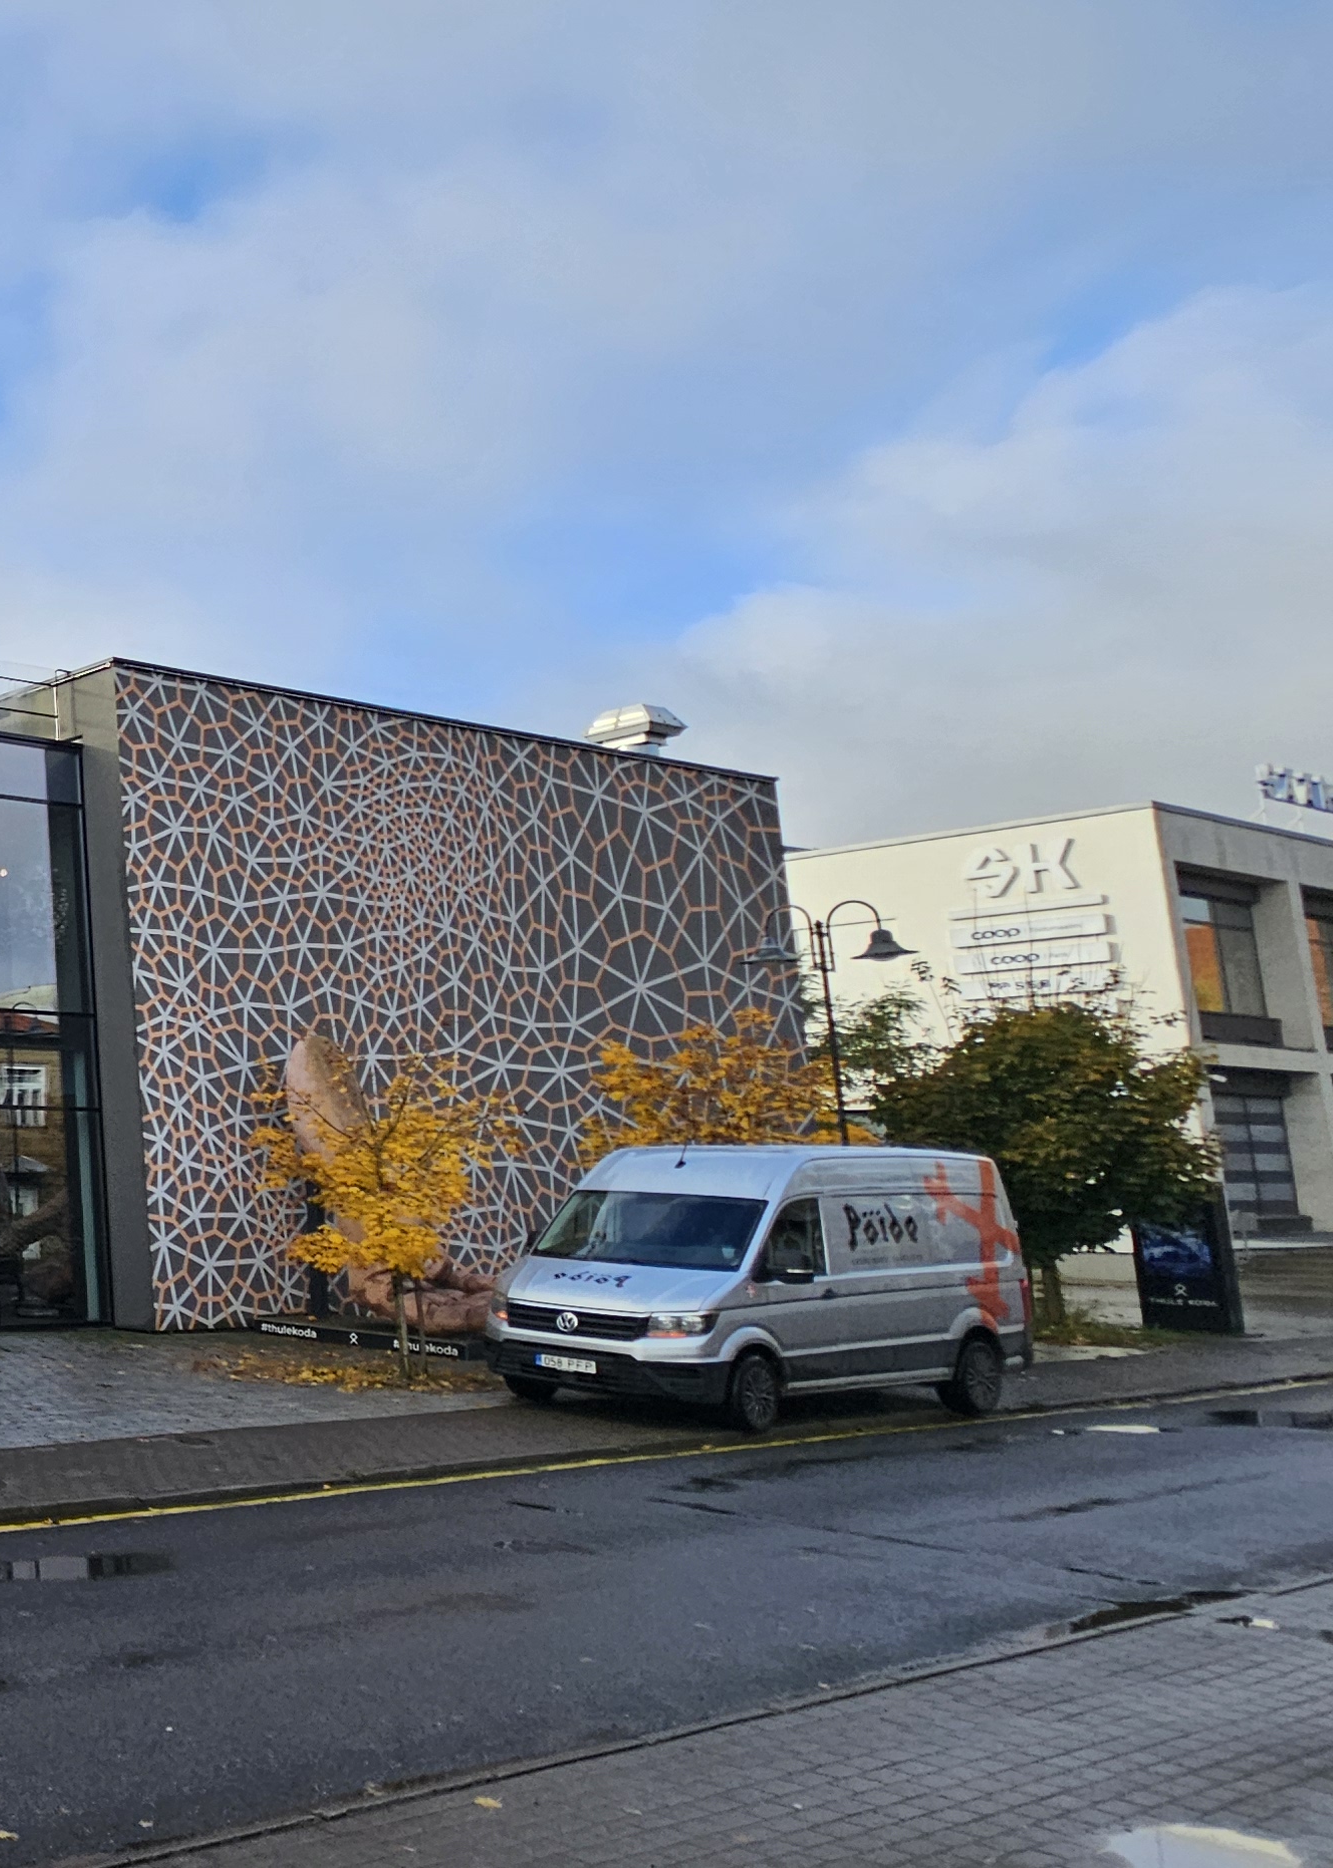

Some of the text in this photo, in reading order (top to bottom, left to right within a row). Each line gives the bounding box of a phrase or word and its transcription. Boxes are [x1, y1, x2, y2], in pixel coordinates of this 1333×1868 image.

[971, 927, 1021, 941] coop
[990, 952, 1040, 965] coop
[260, 1322, 318, 1339] #thulekoda
